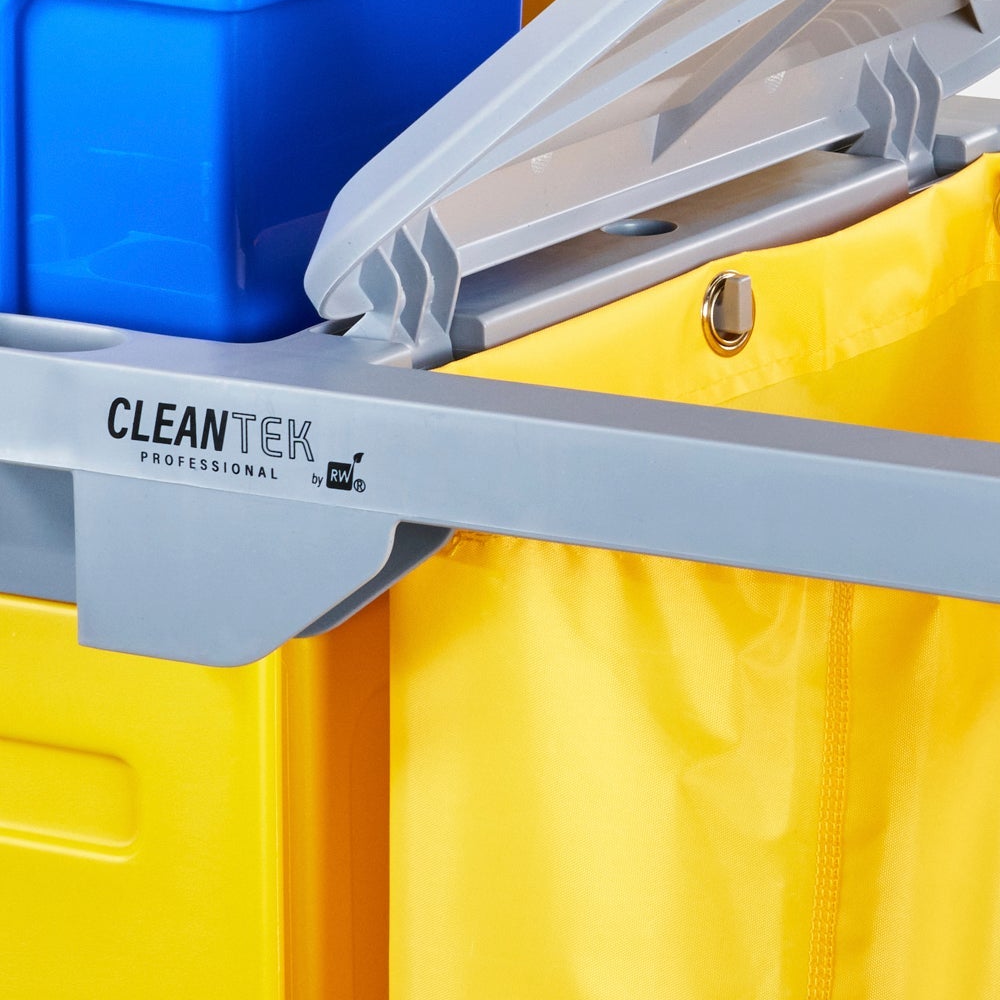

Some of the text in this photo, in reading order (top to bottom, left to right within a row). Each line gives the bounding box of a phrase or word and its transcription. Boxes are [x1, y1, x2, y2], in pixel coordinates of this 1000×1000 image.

[107, 396, 315, 462] CLEANTEK
[140, 451, 278, 480] PROFESSIONAL
[311, 472, 323, 486] by
